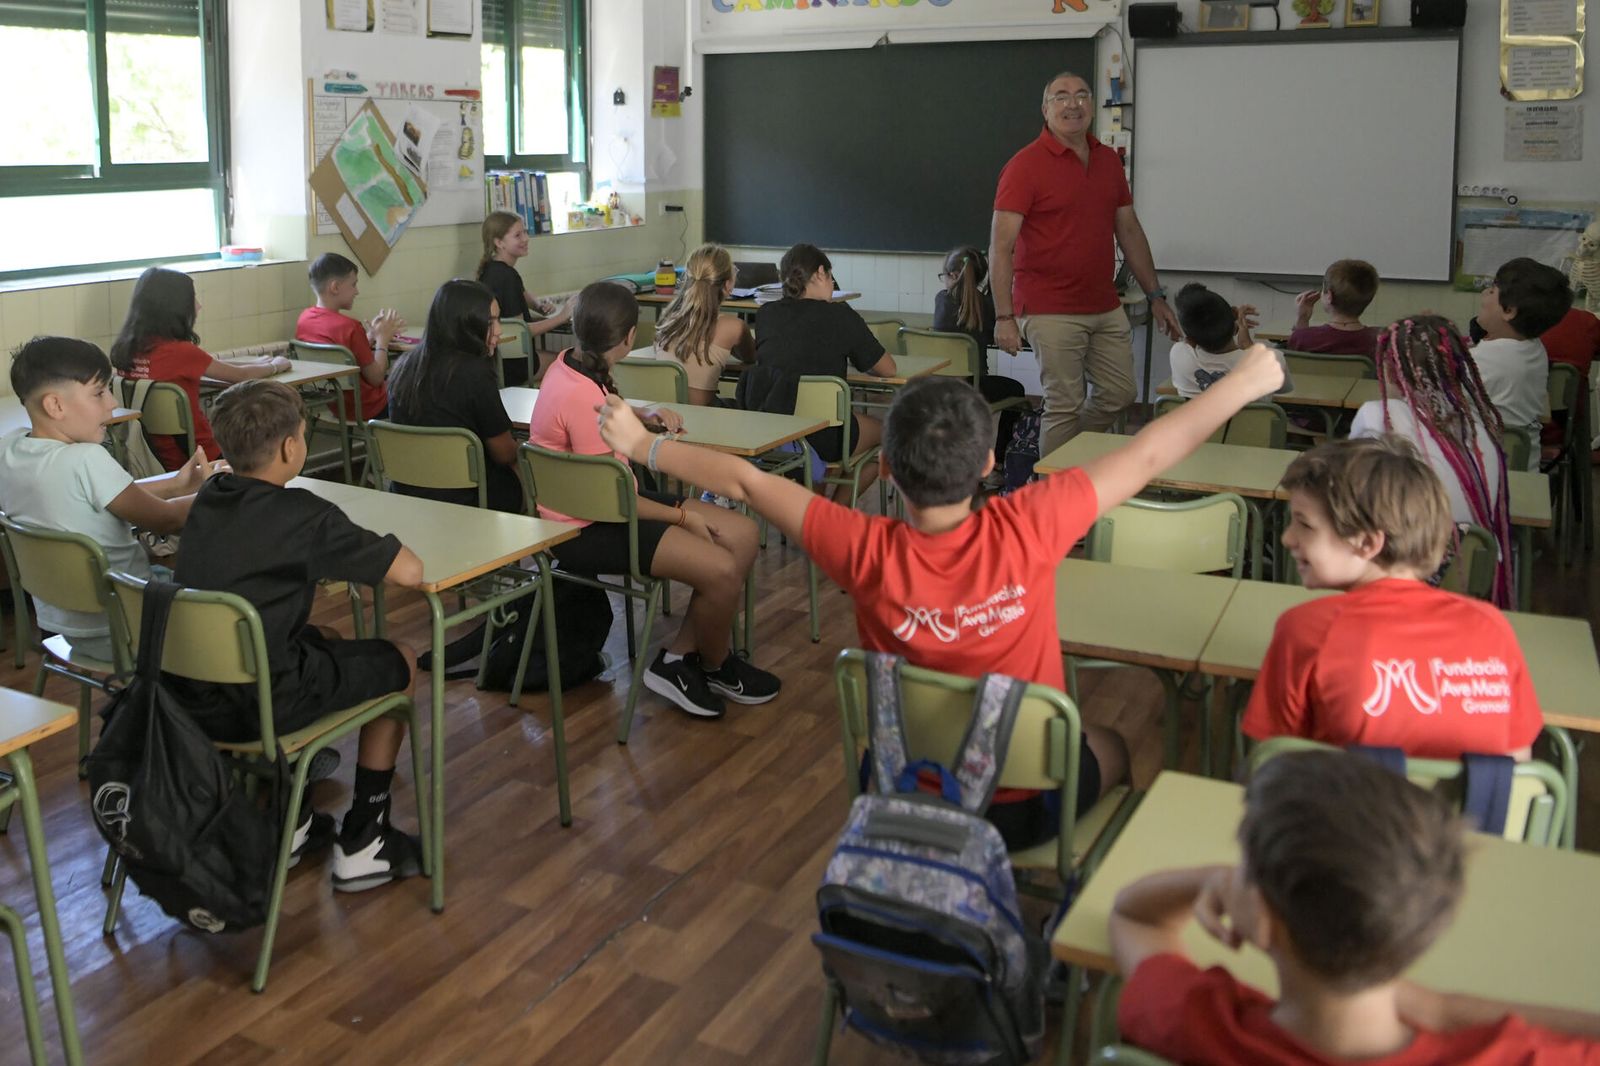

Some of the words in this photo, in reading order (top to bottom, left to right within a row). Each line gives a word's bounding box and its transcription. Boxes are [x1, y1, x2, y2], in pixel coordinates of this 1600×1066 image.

[376, 82, 435, 98] TAREAS
[961, 612, 988, 626] Ave
[1441, 678, 1471, 697] Ave
[1471, 678, 1510, 697] Marí
[1462, 698, 1510, 714] Granad
